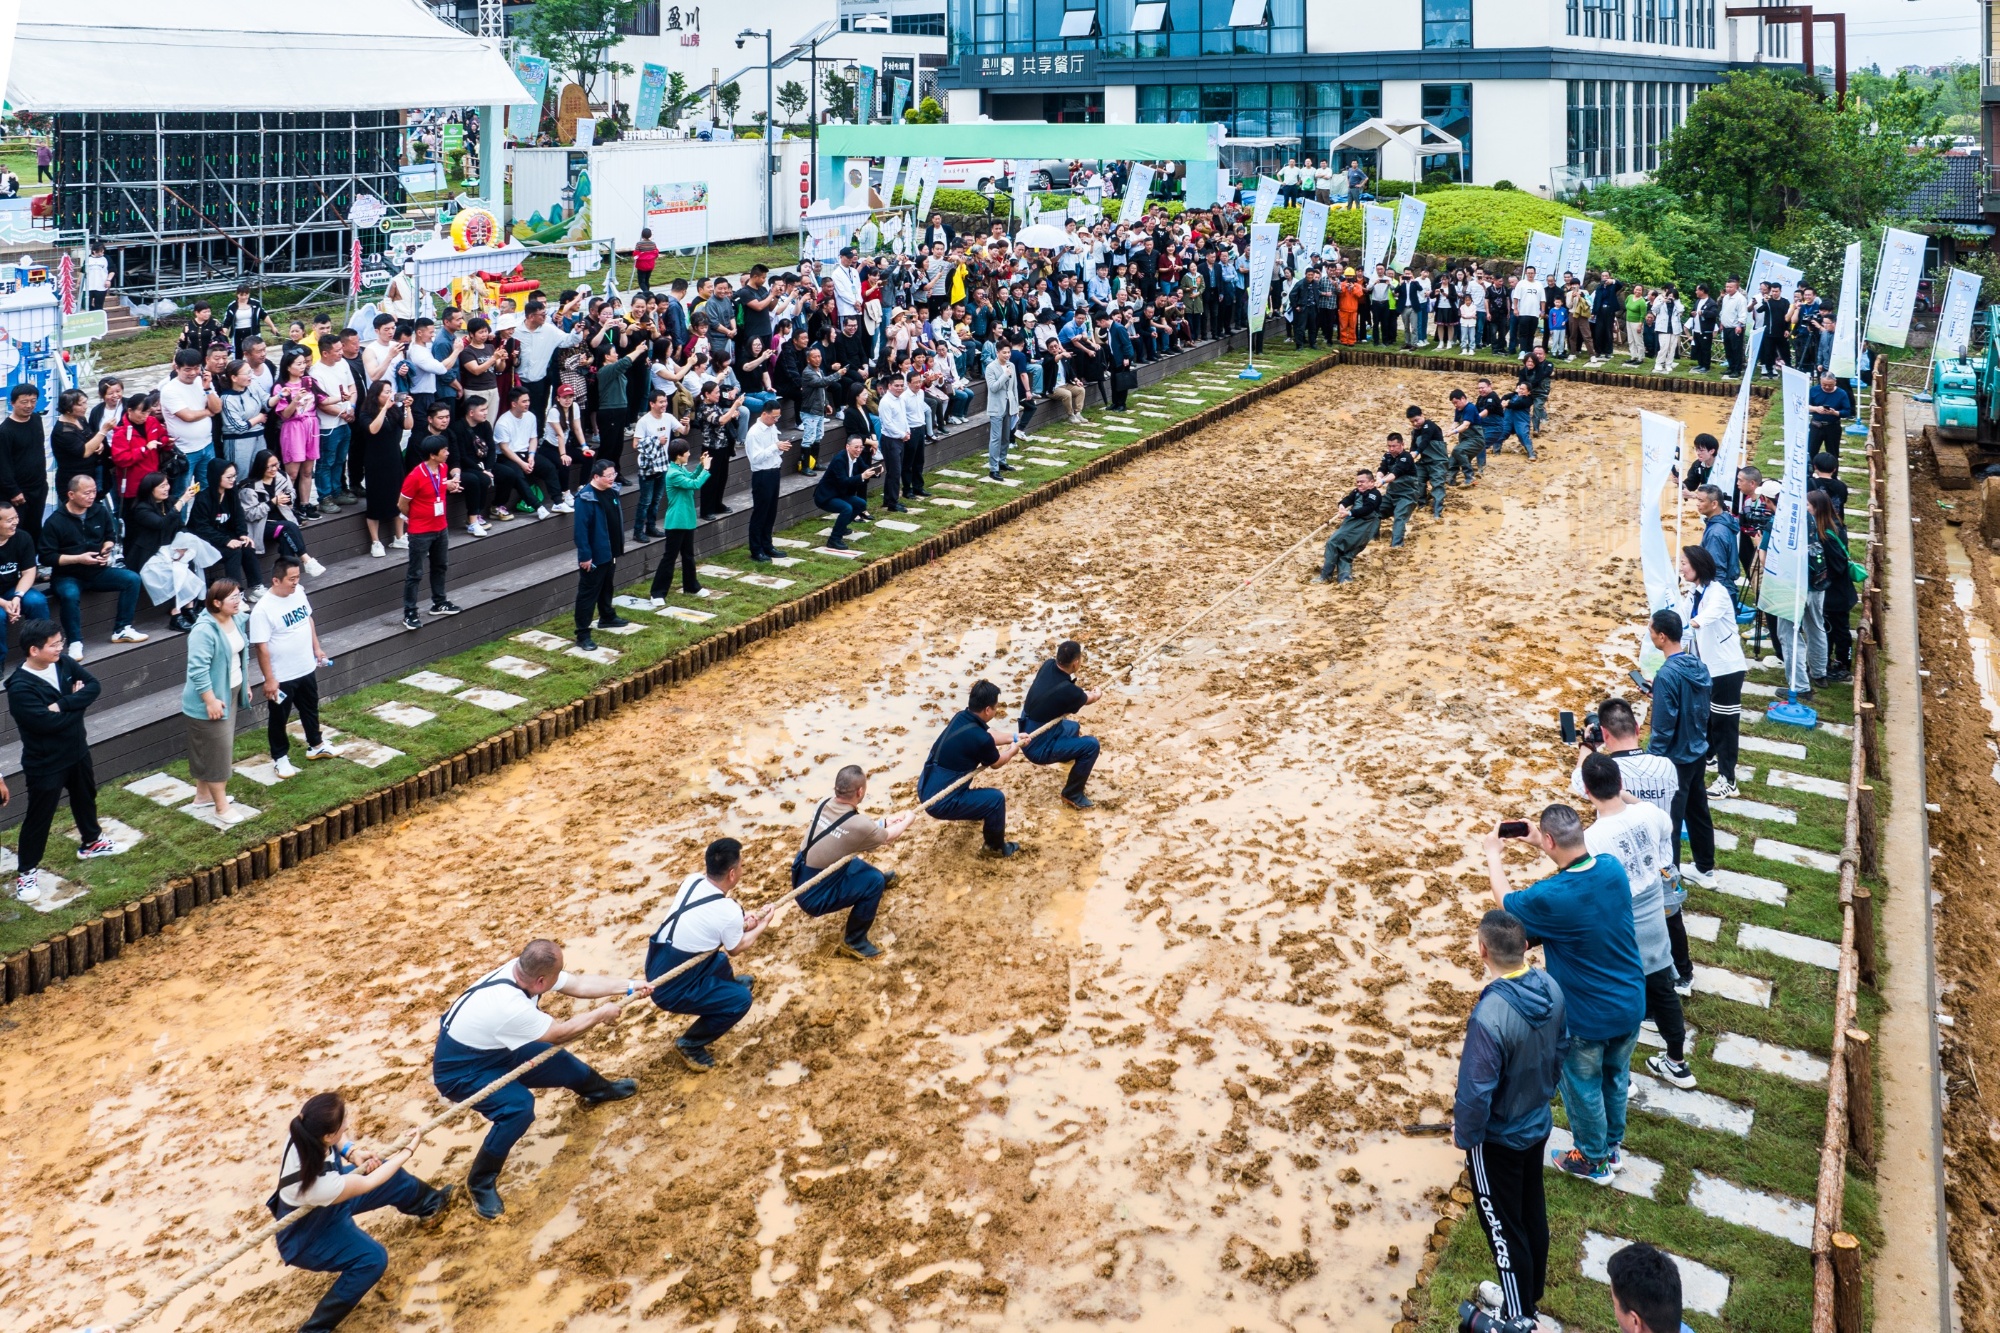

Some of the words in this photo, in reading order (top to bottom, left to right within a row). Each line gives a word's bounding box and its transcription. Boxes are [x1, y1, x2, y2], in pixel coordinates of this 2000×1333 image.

[665, 5, 700, 32] 盈川
[680, 33, 700, 47] 山房
[981, 58, 999, 69] 盈川
[1022, 54, 1085, 75] 共享餐厅
[1480, 1196, 1510, 1269] adidas
